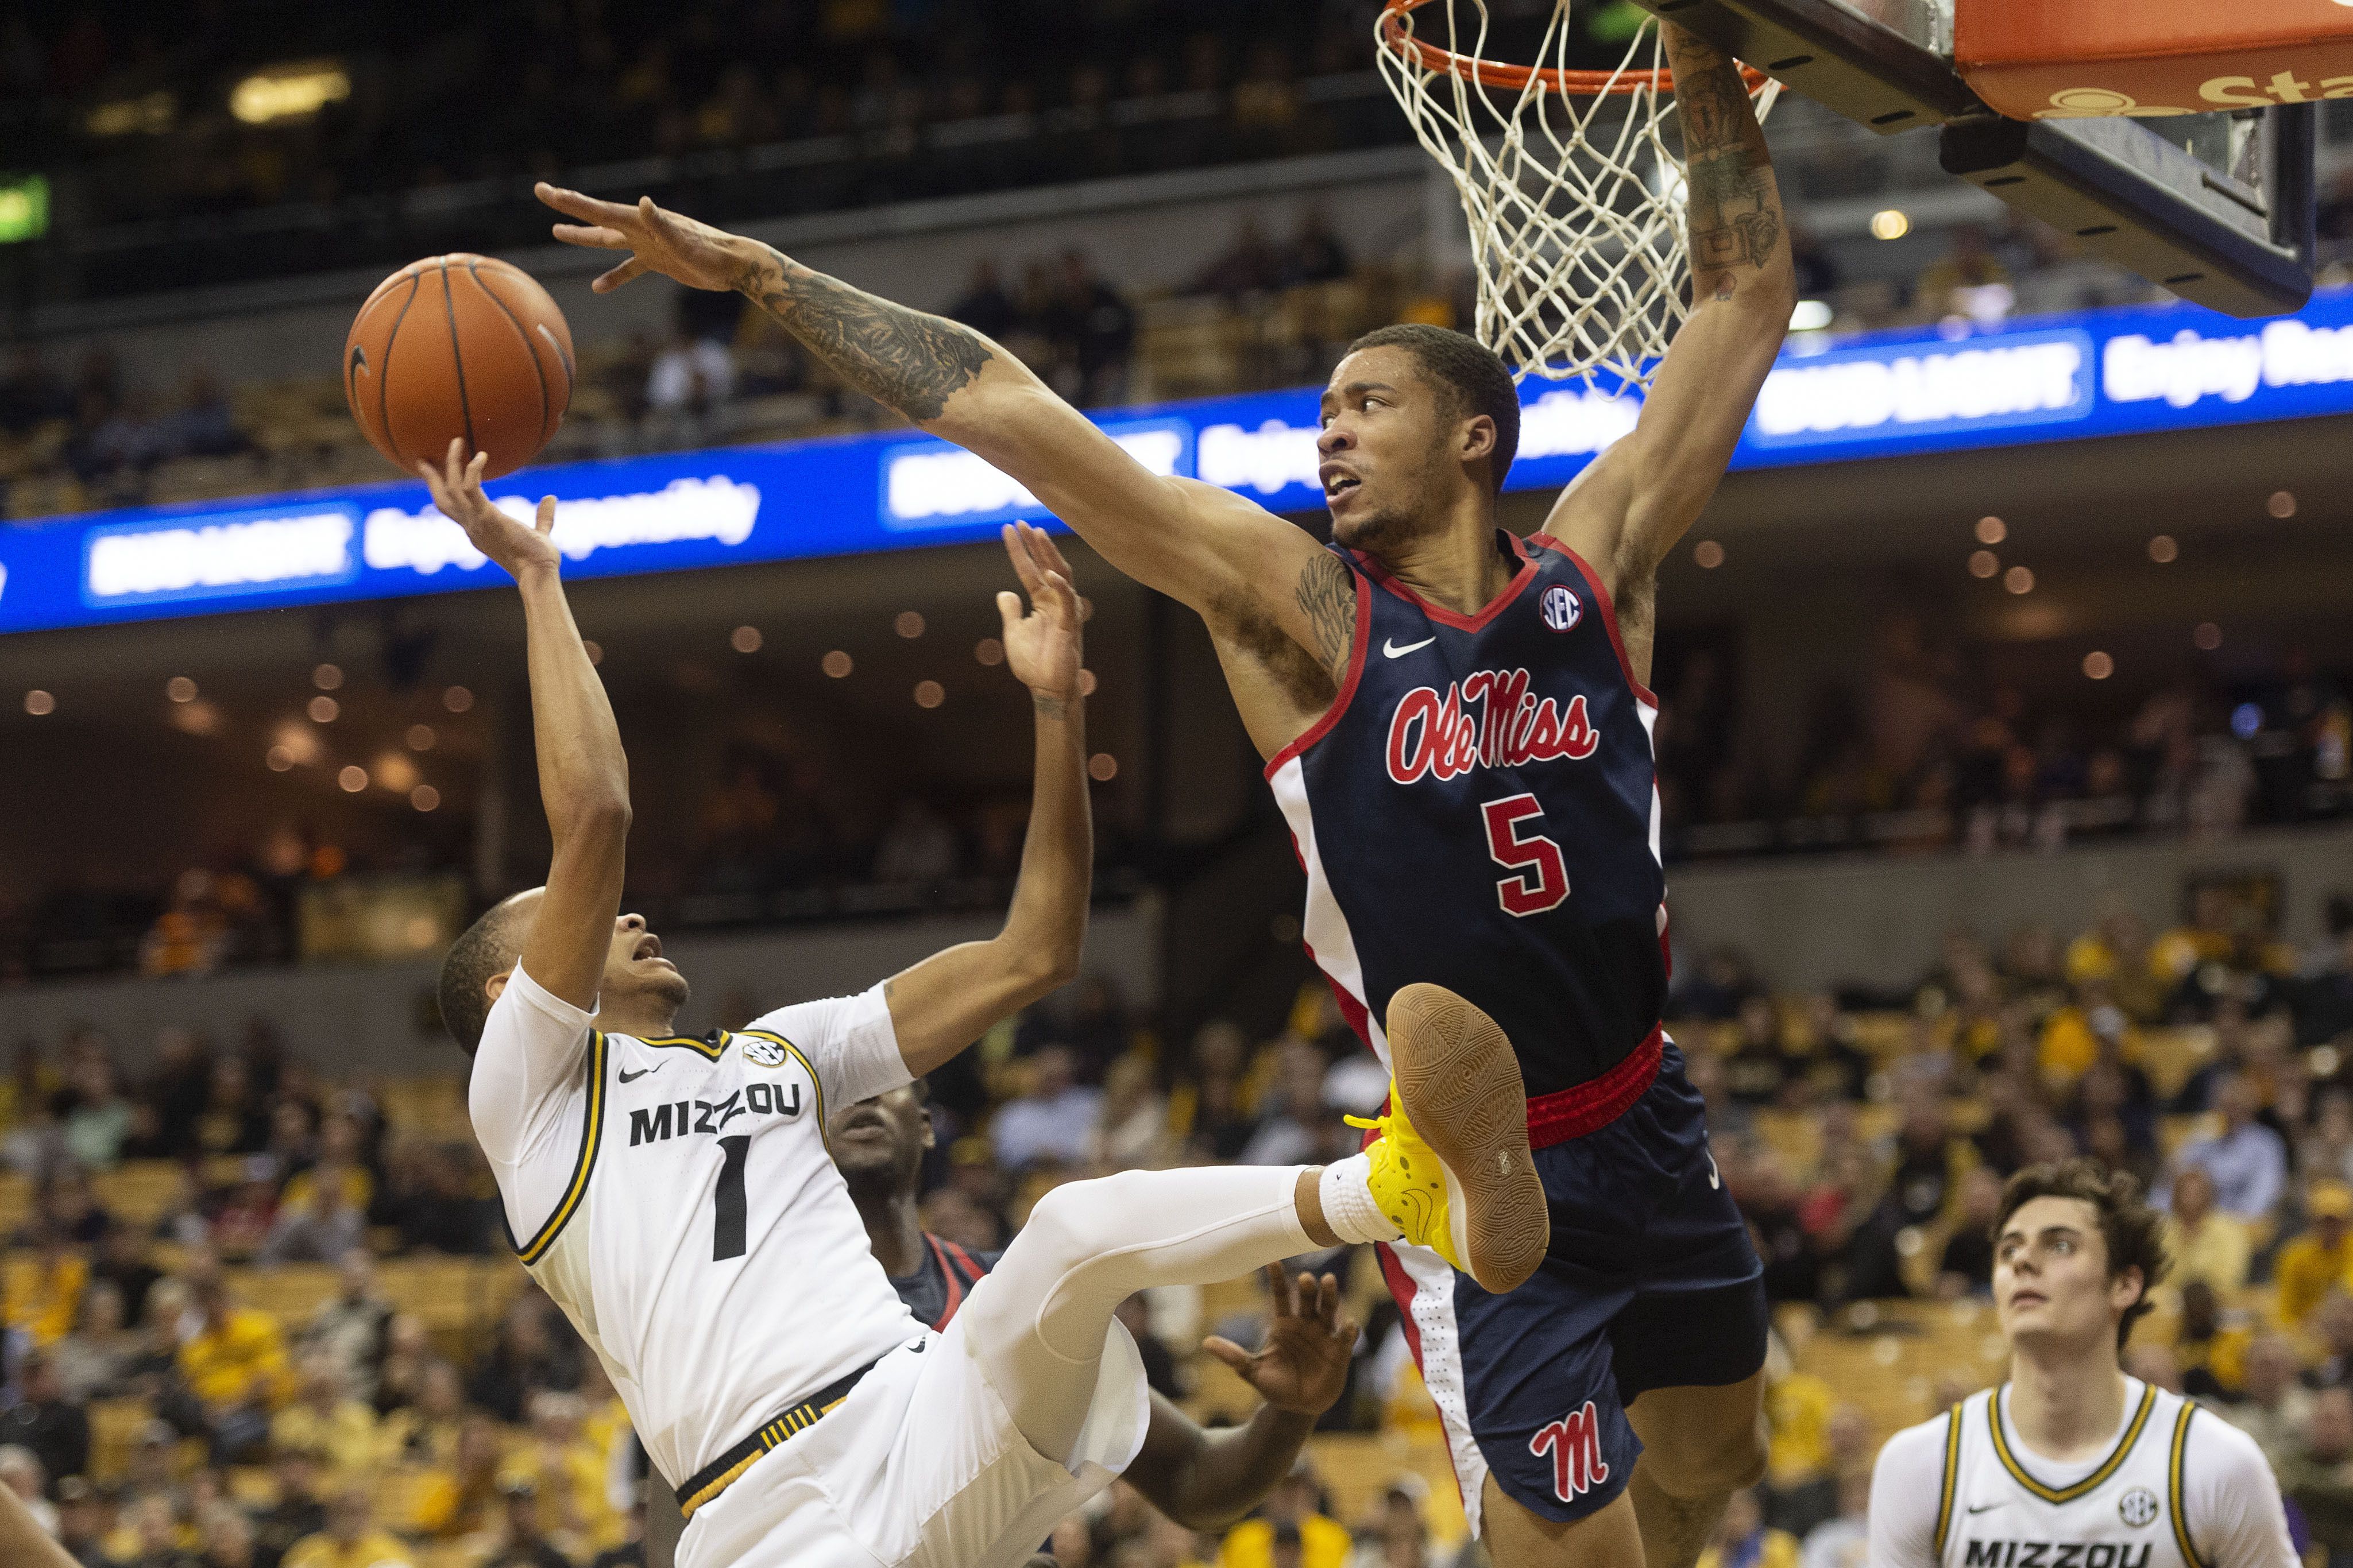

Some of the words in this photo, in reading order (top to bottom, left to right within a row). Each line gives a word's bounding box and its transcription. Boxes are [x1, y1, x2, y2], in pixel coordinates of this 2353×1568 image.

[1543, 588, 1580, 630] SEC
[1386, 682, 1478, 784] Ole
[1462, 668, 1600, 768] Miss
[1481, 793, 1571, 917] 5
[743, 1040, 785, 1066] SEC
[629, 1083, 800, 1147] MIZZOU
[713, 1135, 752, 1262] 1
[1965, 1540, 2154, 1568] MIZZOU
